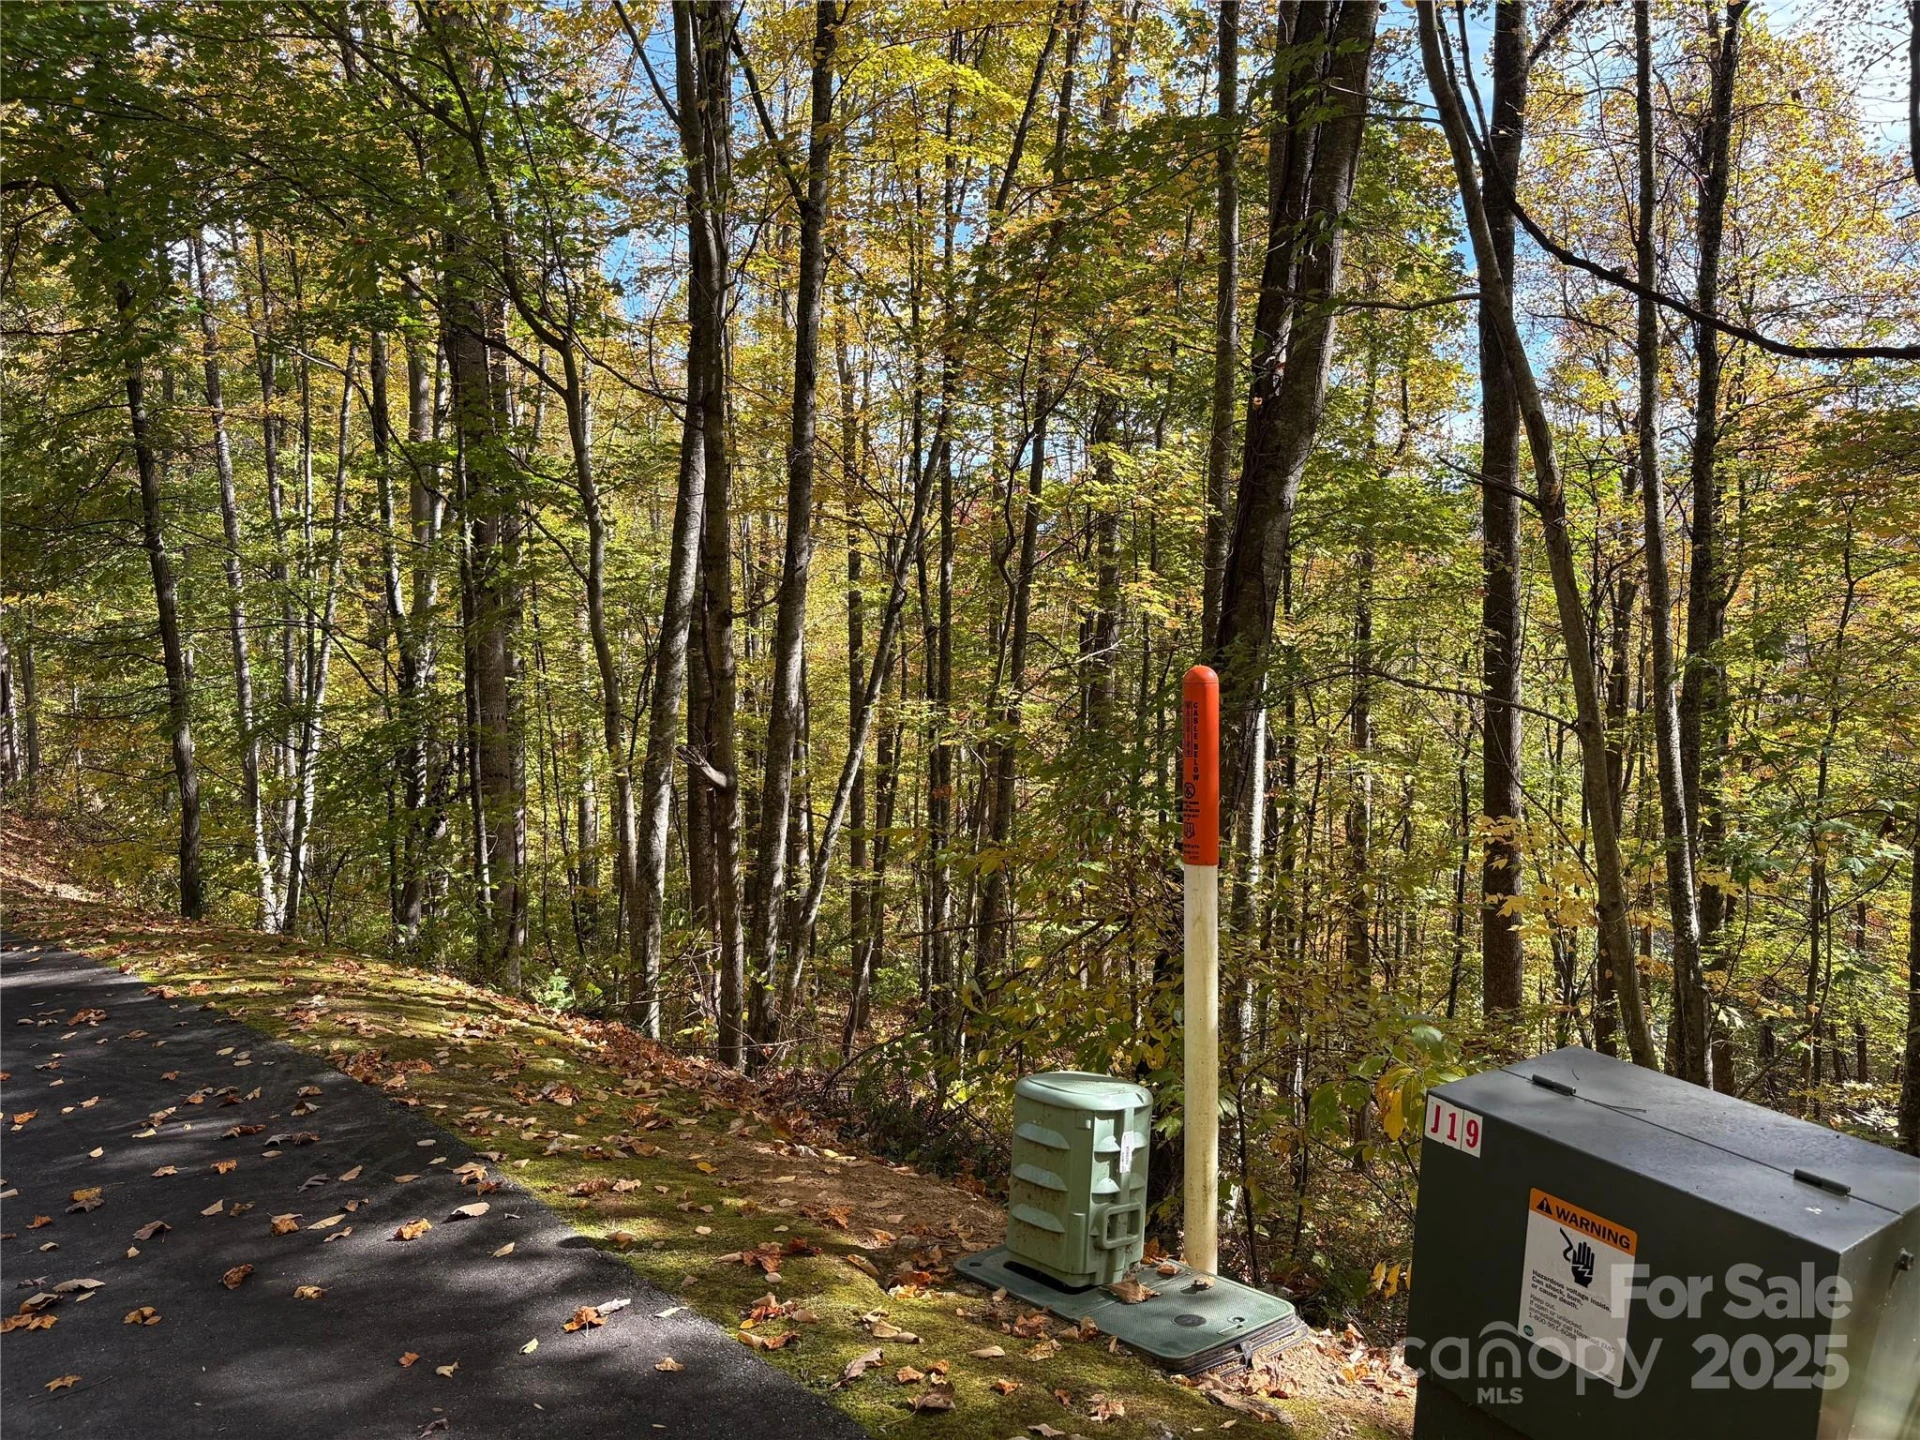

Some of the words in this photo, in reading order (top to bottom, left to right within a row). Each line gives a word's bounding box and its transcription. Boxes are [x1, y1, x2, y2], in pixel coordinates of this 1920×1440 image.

[1431, 1104, 1478, 1148] J19
[1556, 1205, 1630, 1250] WARNING
[1532, 1276, 1543, 1286] Can
[1533, 1269, 1564, 1289] Hazardous
[1566, 1286, 1588, 1301] voltage
[1591, 1297, 1611, 1312] inside.
[1539, 1287, 1557, 1299] cause
